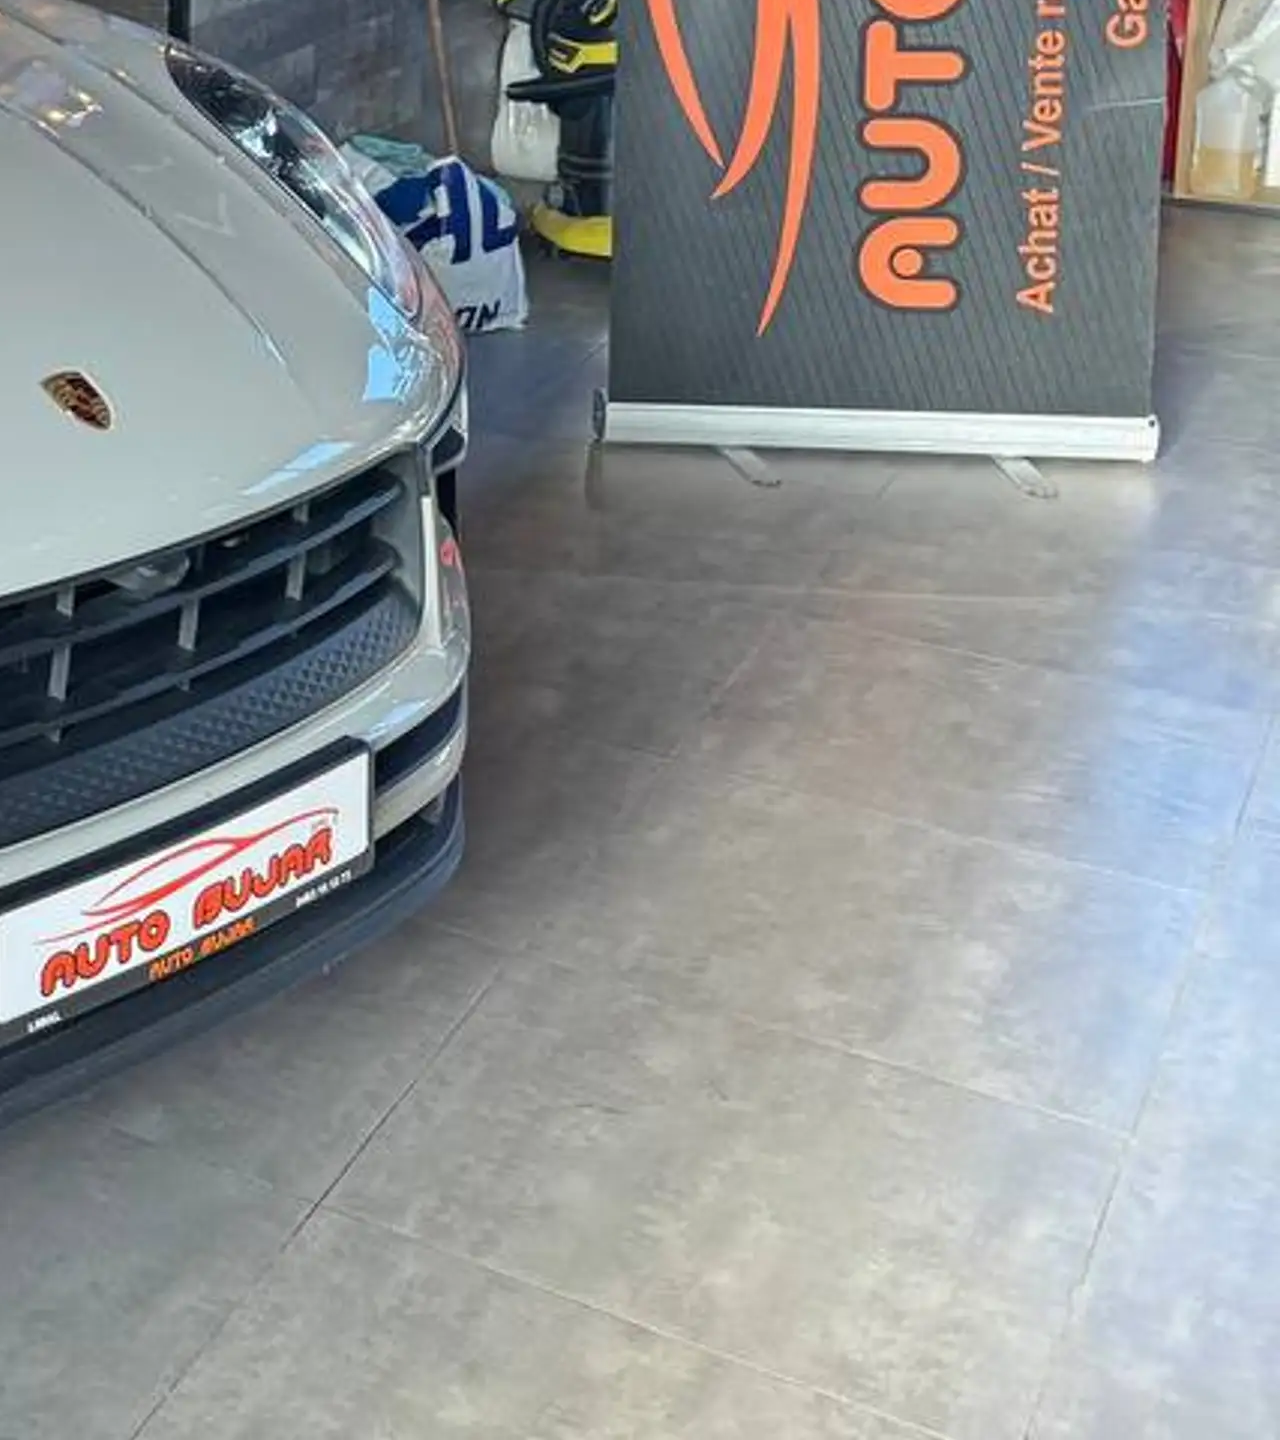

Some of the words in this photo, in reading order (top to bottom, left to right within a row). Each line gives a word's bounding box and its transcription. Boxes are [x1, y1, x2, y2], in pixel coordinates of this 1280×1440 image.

[1023, 31, 1067, 152] Vente
[1017, 189, 1059, 313] Achat
[39, 910, 171, 998] AUTO
[192, 826, 333, 930] BUJAR
